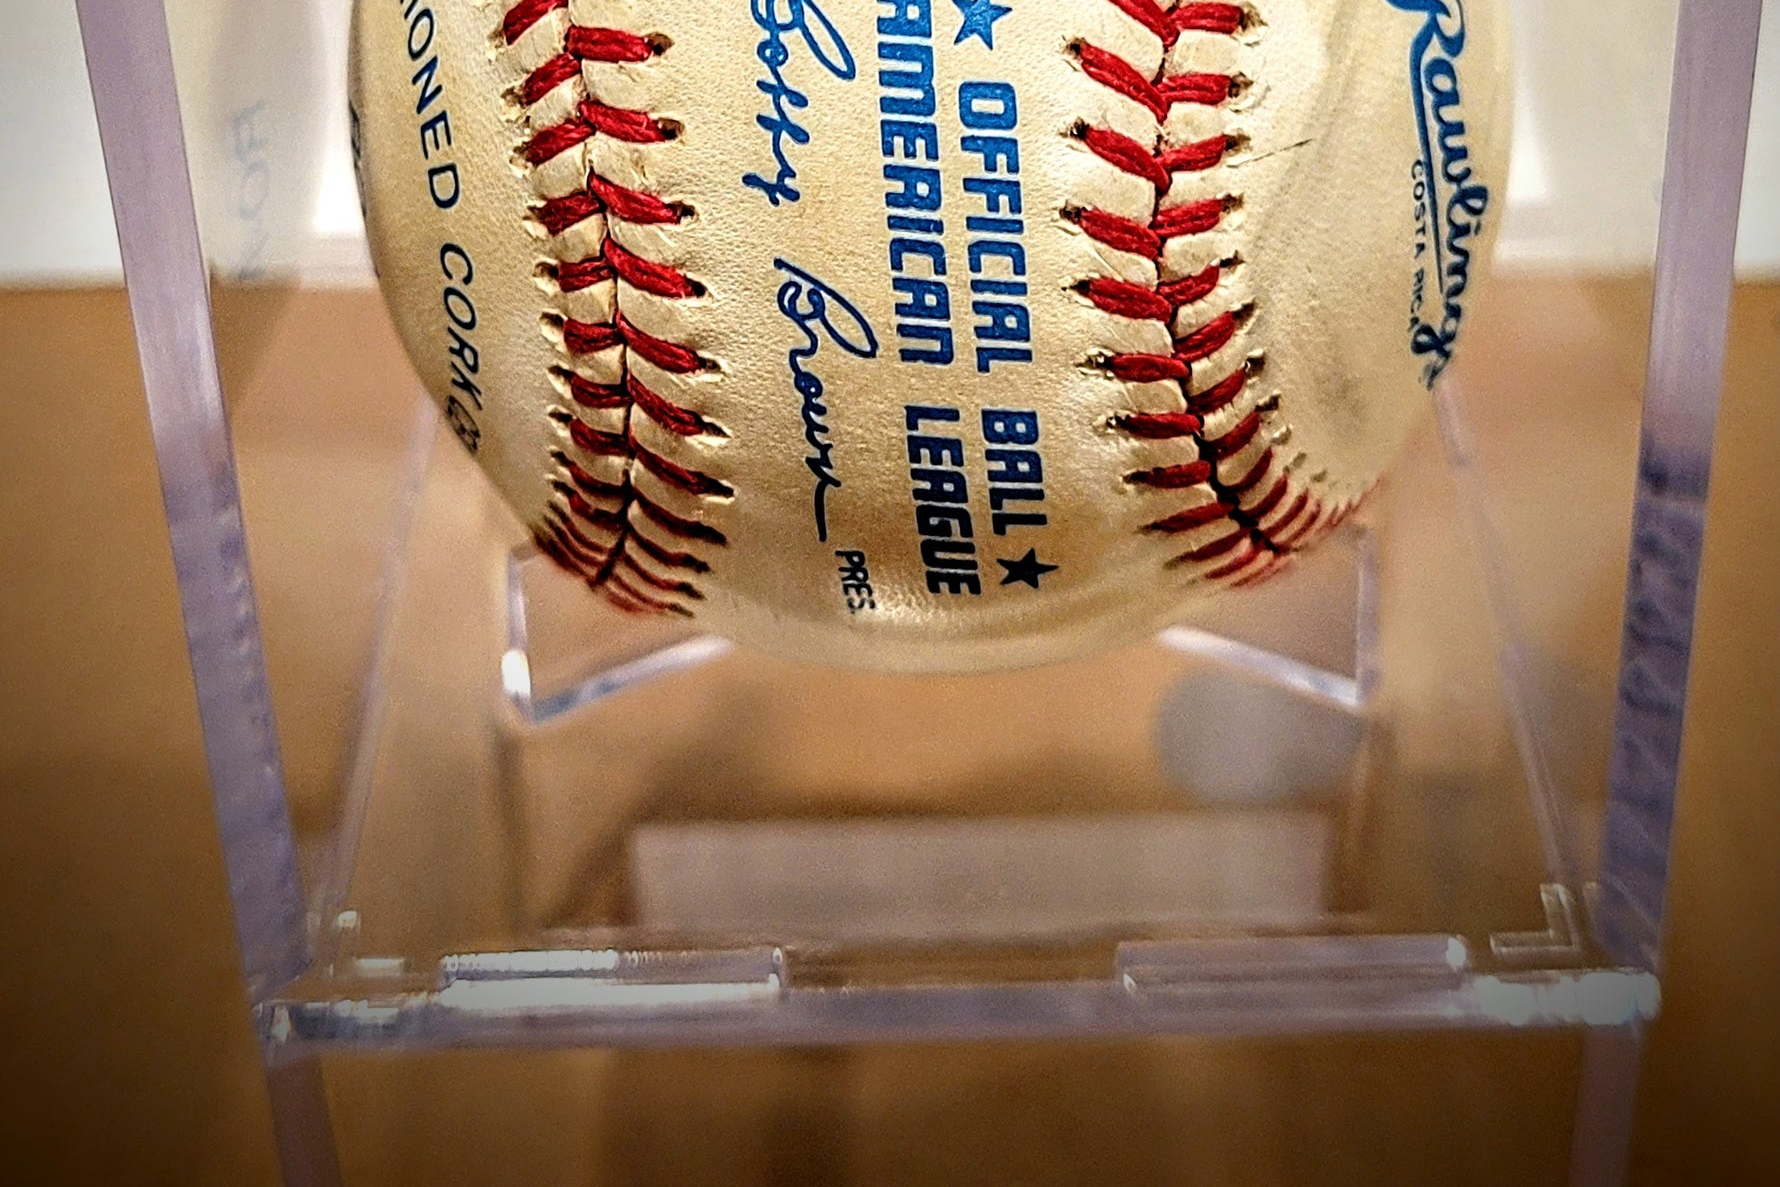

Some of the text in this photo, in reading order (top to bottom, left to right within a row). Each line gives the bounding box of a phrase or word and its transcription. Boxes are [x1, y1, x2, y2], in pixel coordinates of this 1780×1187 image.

[440, 242, 483, 411] CORK
[958, 81, 1048, 536] OFFICIAL BALL
[1407, 159, 1427, 334] COSTA RICA
[904, 405, 982, 596] LEAGUE
